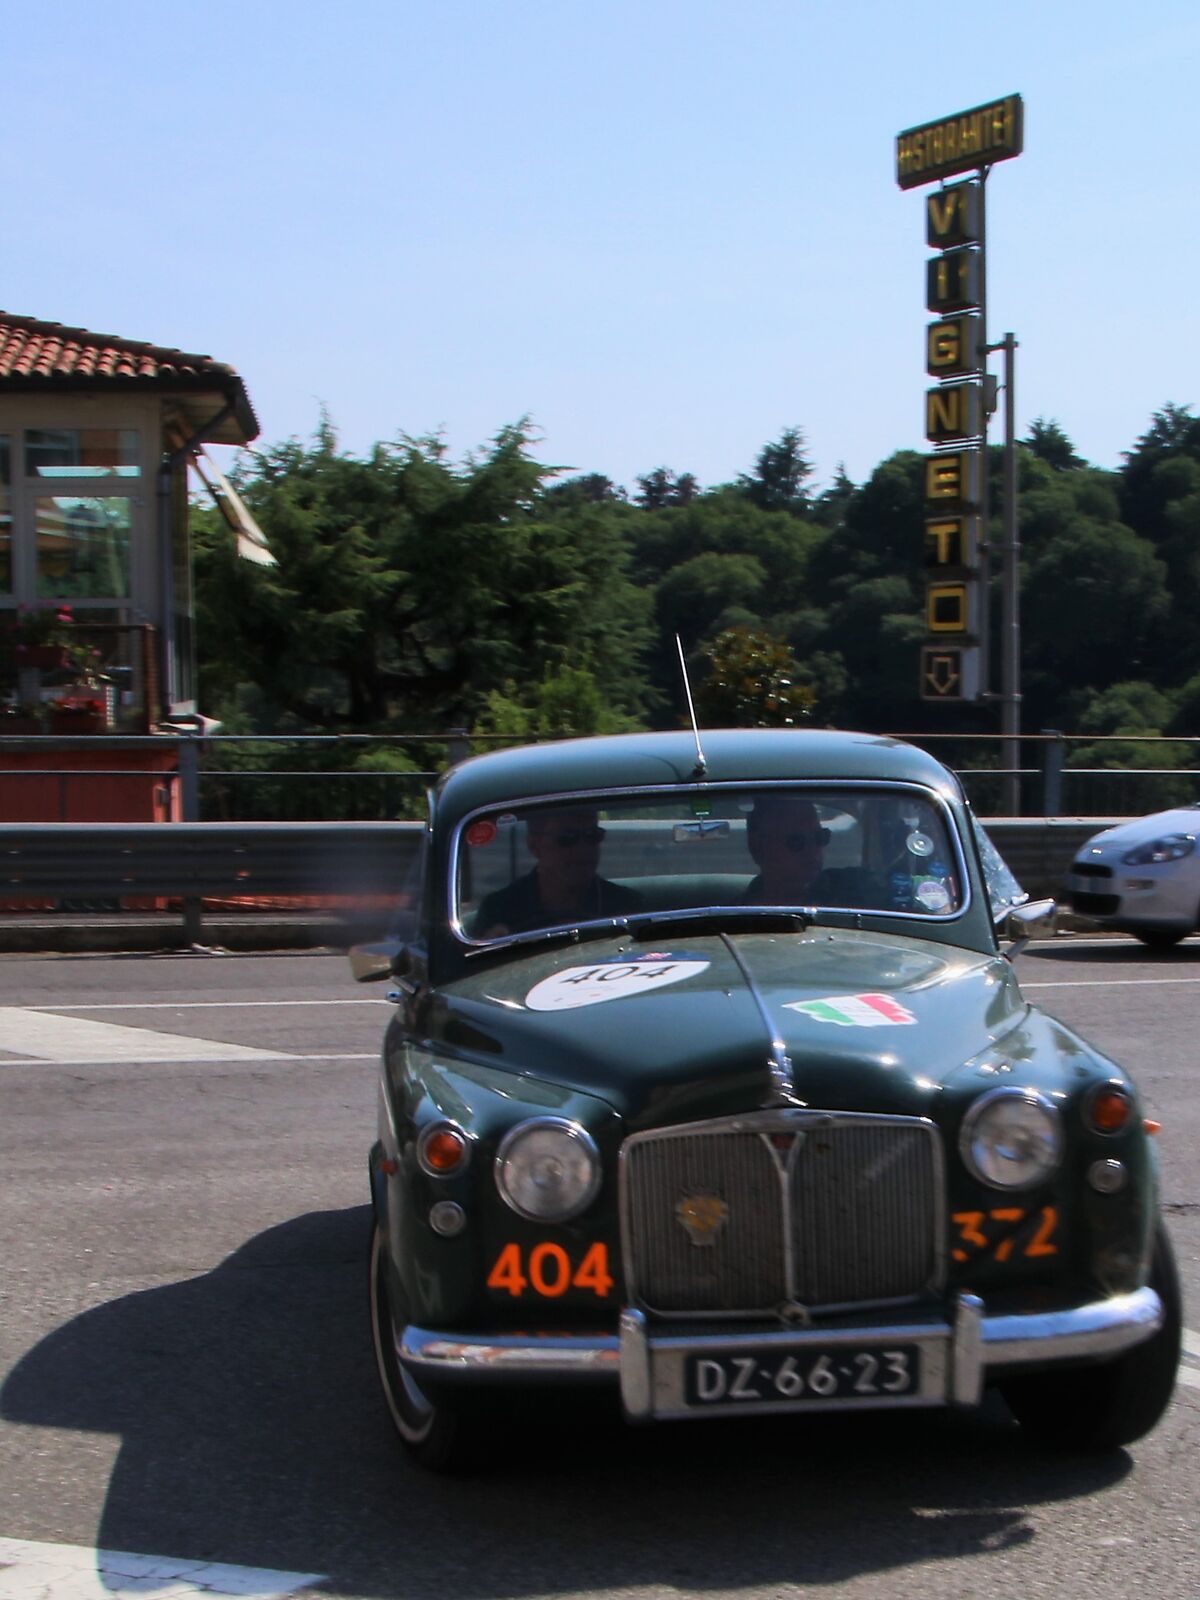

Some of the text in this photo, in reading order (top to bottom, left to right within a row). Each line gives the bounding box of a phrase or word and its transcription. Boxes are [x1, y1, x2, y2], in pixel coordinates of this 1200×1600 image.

[926, 192, 966, 632] VIGNETO
[558, 964, 678, 985] 404
[487, 1242, 614, 1297] 404
[696, 1351, 911, 1400] DZ-66-23
